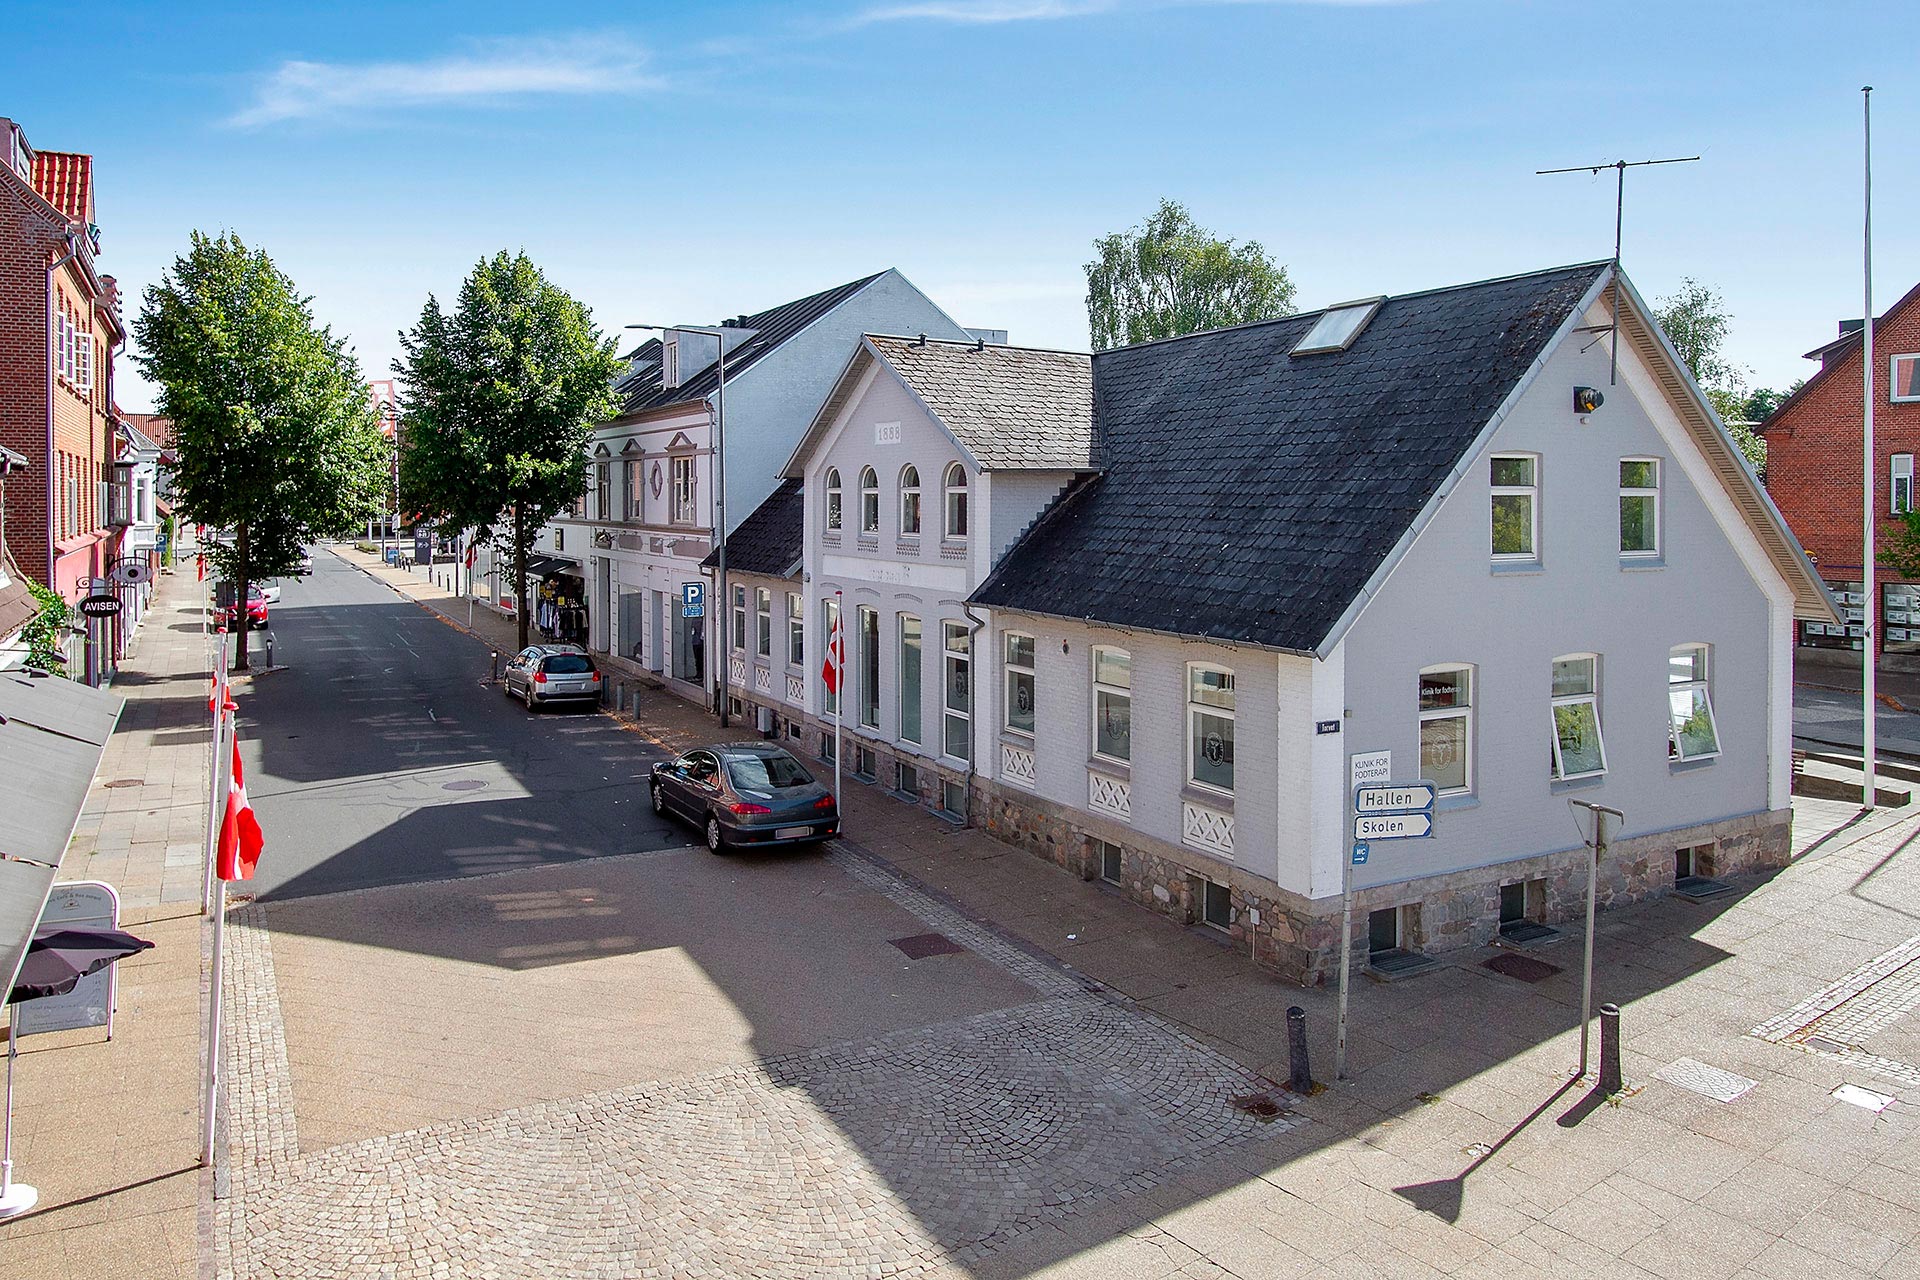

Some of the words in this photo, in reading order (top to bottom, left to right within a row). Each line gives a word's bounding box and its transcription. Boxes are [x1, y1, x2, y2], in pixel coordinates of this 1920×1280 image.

[879, 427, 900, 440] 1888
[687, 586, 700, 603] P
[84, 602, 119, 611] AVISEN
[1354, 760, 1375, 769] KLINIK
[1376, 758, 1388, 766] FOR
[1354, 768, 1388, 779] FODTERAPI
[1366, 792, 1412, 806] Hallen
[1362, 820, 1404, 833] Skolen
